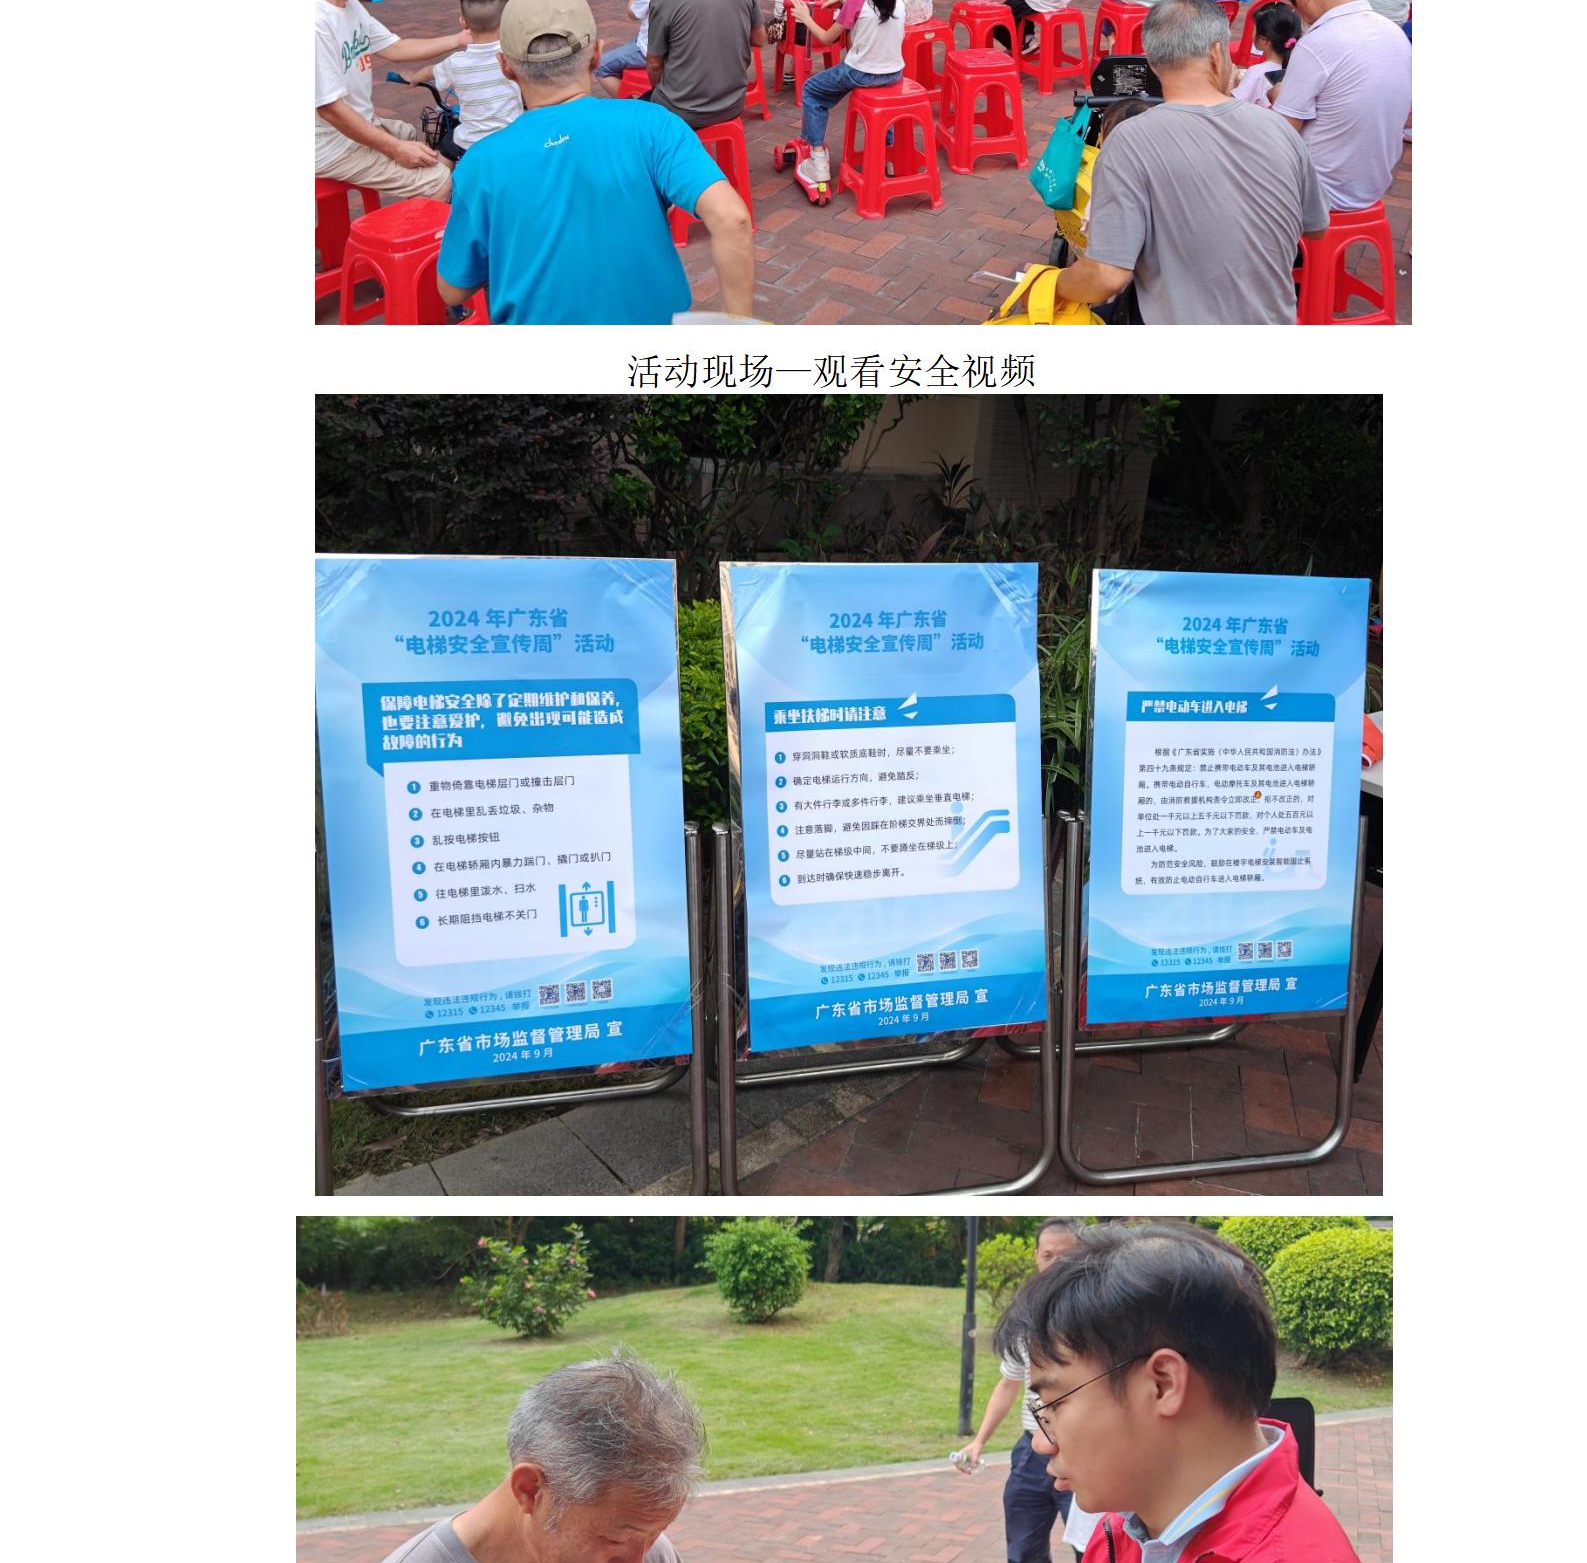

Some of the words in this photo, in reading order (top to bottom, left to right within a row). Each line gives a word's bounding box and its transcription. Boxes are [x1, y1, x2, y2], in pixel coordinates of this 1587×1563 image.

[627, 353, 1035, 389] 活动现场—观看安全视频
[428, 609, 480, 628] 2024
[486, 607, 568, 629] 年广东省
[830, 612, 873, 629] 2024
[878, 609, 947, 629] 年广东省
[1182, 616, 1221, 632] 2024
[1226, 616, 1289, 635] 年广东省
[395, 633, 562, 656] “电梯安全宣传周”
[575, 633, 614, 653] 活动
[801, 633, 941, 655] “电梯安全宣传周”
[951, 632, 984, 651] 活动
[1156, 637, 1282, 656] “电梯安全宣传周”
[1290, 639, 1320, 657] 活动
[381, 690, 621, 712] 保障电梯安全除了定期维护和保养，
[1141, 699, 1248, 714] 严禁电动车进入电梯
[773, 706, 886, 725] 乘坐扶梯时请注意
[382, 732, 463, 751] 故障的行为
[430, 803, 554, 819] 在电梯里乱丢垃圾、杂物
[432, 832, 500, 846] 乱按电梯按钮
[435, 882, 536, 899] 往电梯里泼水、扫水
[437, 909, 537, 926] 长期阻挡电梯不关门
[867, 972, 889, 981] 12345
[1145, 977, 1280, 999] 广东省市场监督管理局
[1285, 976, 1298, 991] 宣
[815, 990, 969, 1020] 广东省市场监督管理局
[974, 988, 989, 1004] 宣
[1200, 998, 1217, 1007] 2024
[1220, 997, 1228, 1006] 年
[1236, 995, 1244, 1005] 月
[437, 1008, 464, 1018] 12315
[480, 1004, 506, 1014] 12345
[878, 1016, 899, 1026] 2024
[902, 1014, 910, 1024] 年
[921, 1012, 929, 1022] 月
[419, 1022, 600, 1057] 广东省市场监督管理局
[607, 1020, 623, 1037] 宣
[493, 1052, 518, 1063] 2024
[521, 1050, 531, 1061] 年
[543, 1047, 553, 1058] 月
